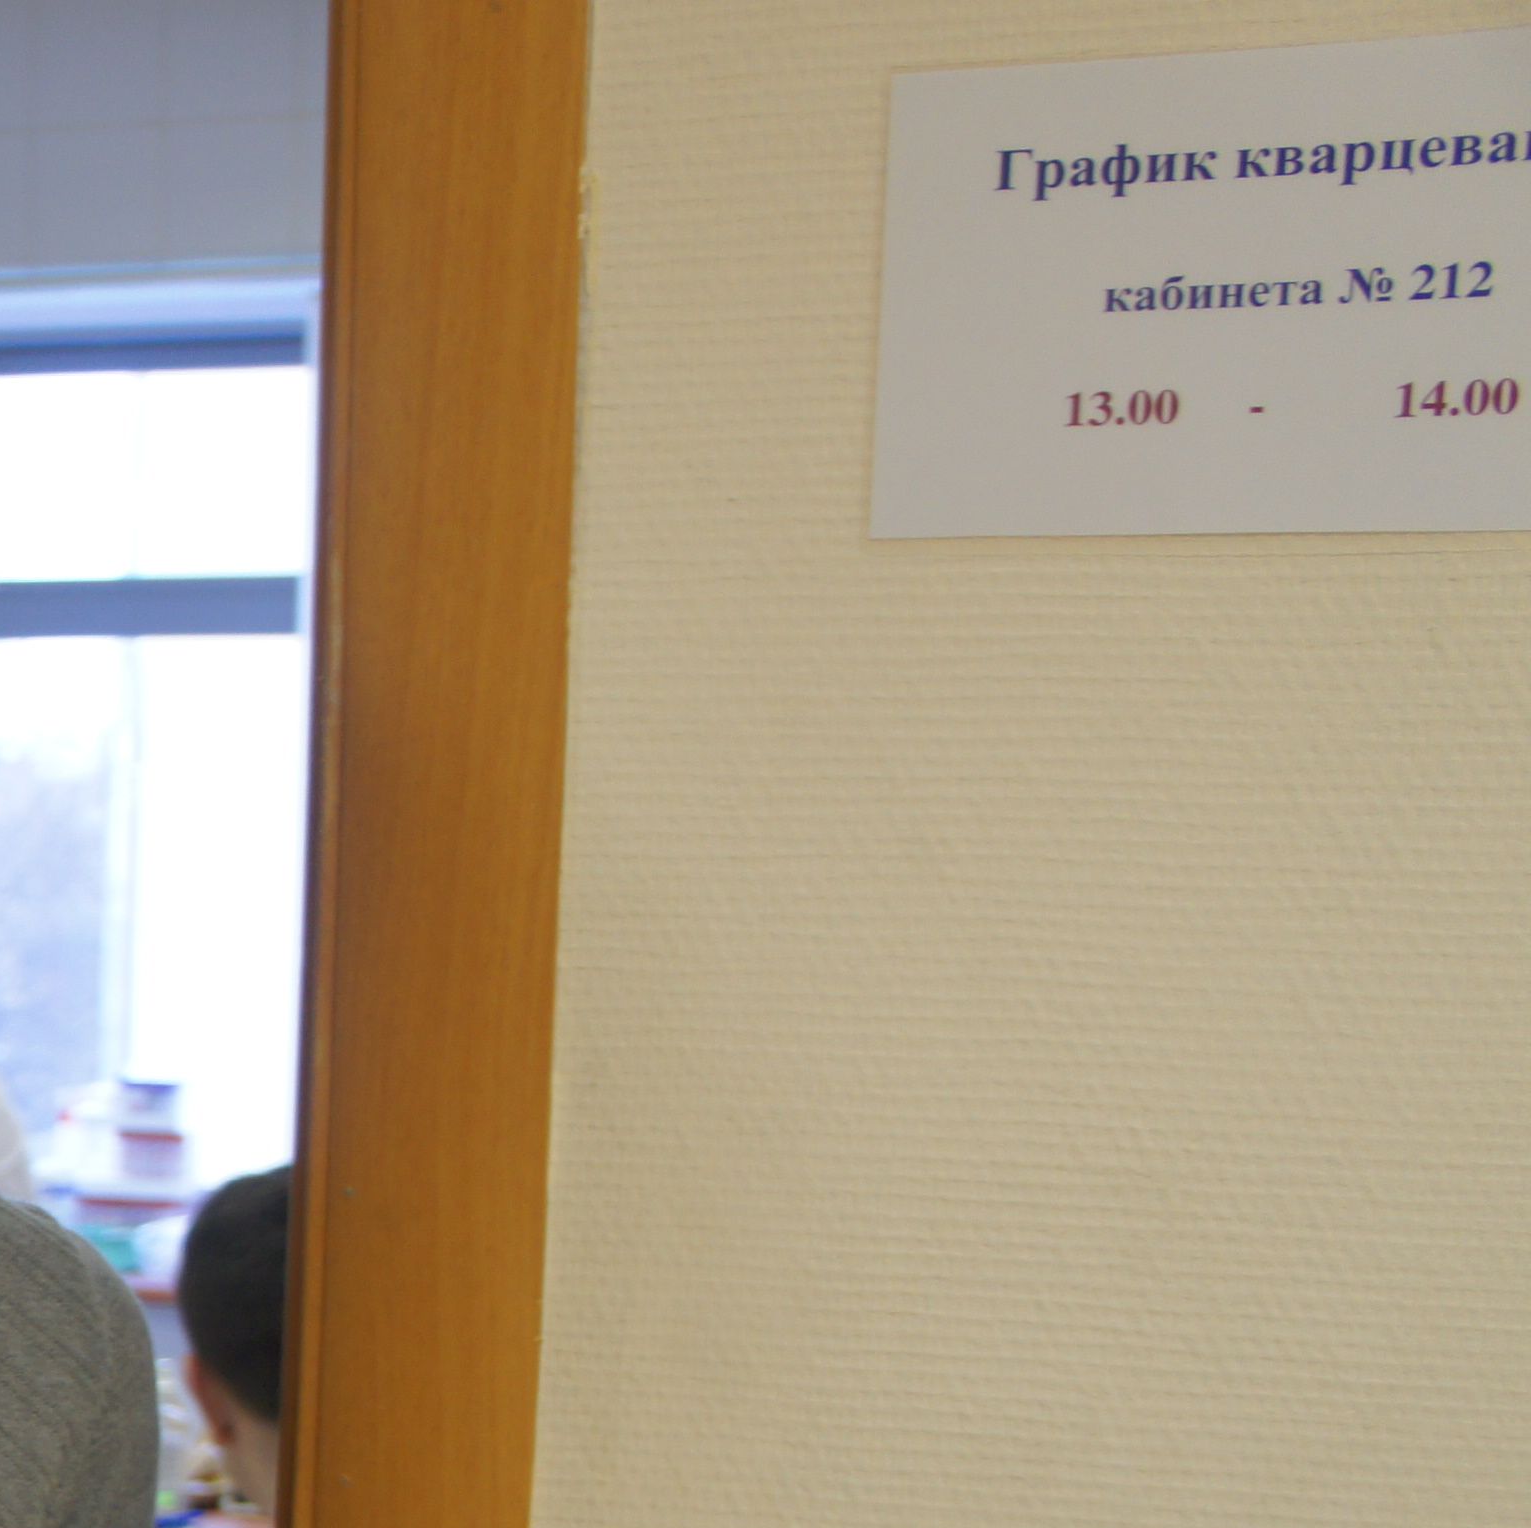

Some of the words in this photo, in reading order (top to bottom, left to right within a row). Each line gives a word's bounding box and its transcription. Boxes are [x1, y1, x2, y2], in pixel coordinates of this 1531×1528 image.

[993, 143, 1217, 201] График
[1102, 276, 1323, 313] кабинета
[1337, 267, 1395, 304] №
[1409, 261, 1495, 301] 212
[1063, 389, 1180, 428] 13.00
[1393, 378, 1520, 419] 14.00
